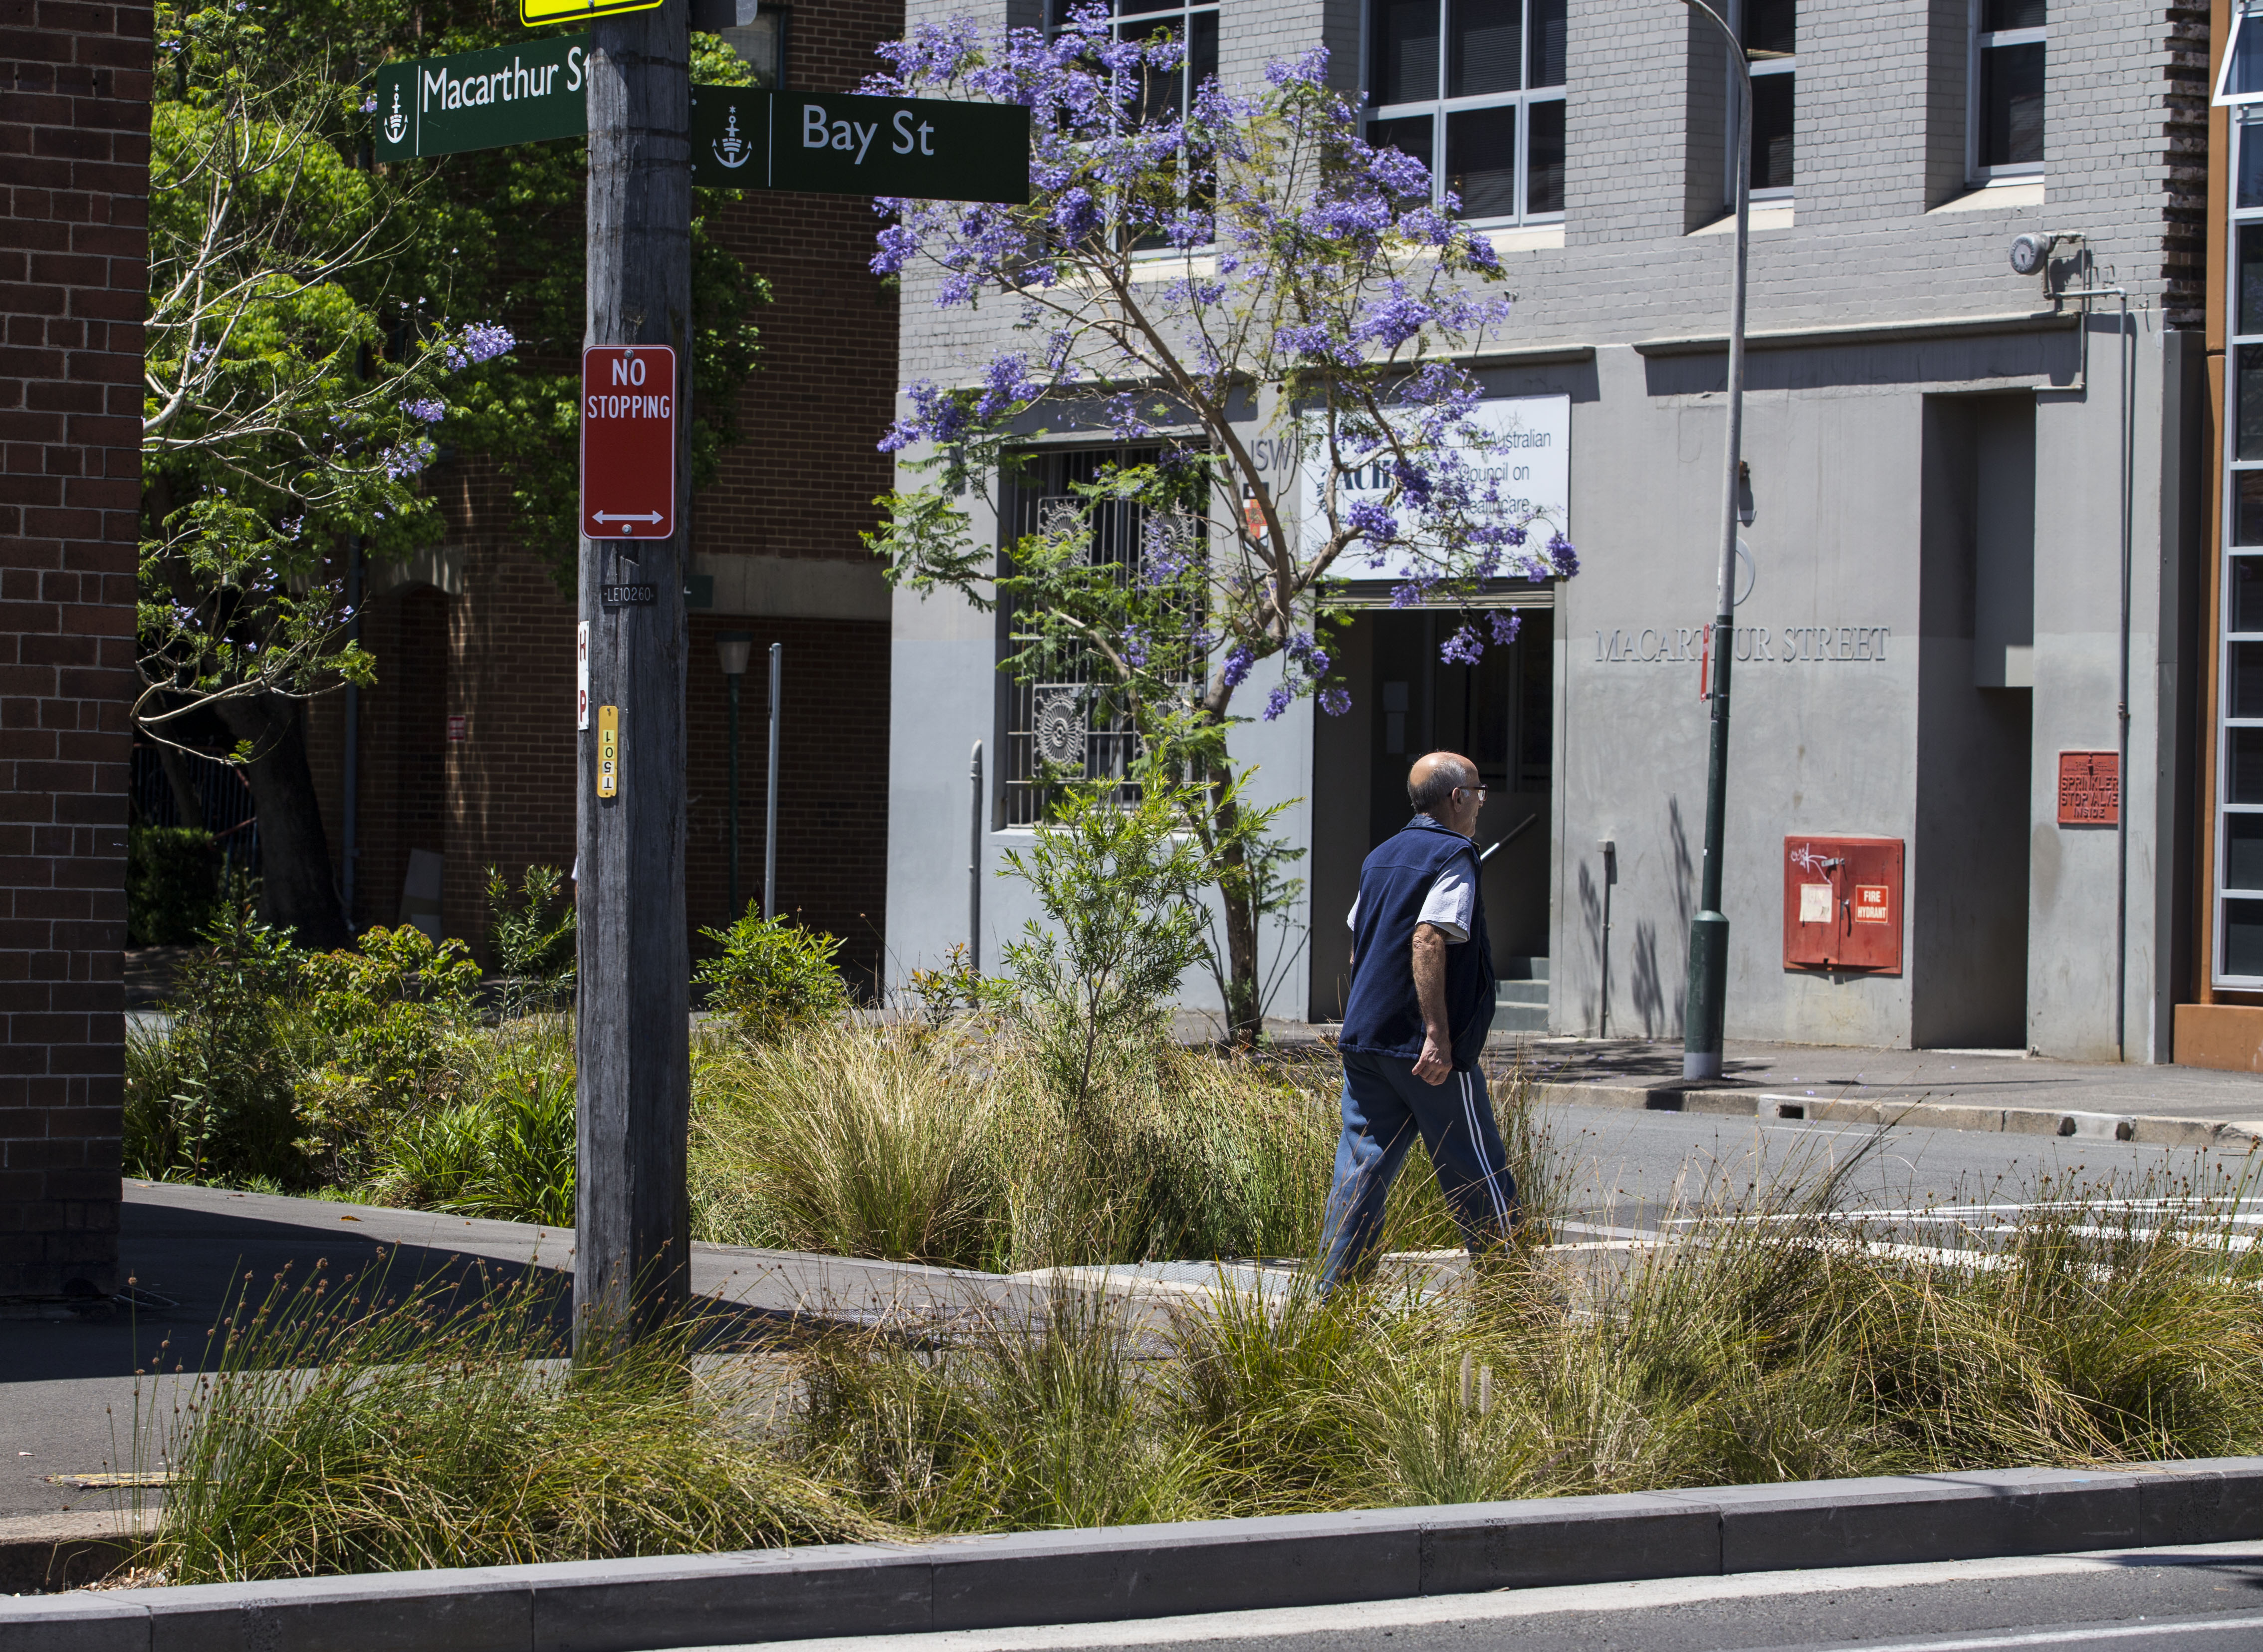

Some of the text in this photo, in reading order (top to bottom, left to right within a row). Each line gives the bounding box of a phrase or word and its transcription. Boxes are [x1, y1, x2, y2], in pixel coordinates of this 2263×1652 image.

[424, 56, 559, 113] Macarthur
[803, 104, 934, 165] Bay St
[612, 359, 646, 386] NO
[588, 395, 670, 418] STOPPING
[1459, 462, 1530, 482] Council on
[1462, 495, 1530, 514] ealthcare
[607, 587, 651, 602] LE10260
[1783, 625, 1890, 663] STREET
[2061, 775, 2118, 791] SPRINKLER
[2061, 791, 2118, 807] STOP VALVE
[2073, 807, 2105, 819] INSIDE
[1864, 890, 1881, 902] FIRE
[1857, 907, 1886, 918] HYDRANT
